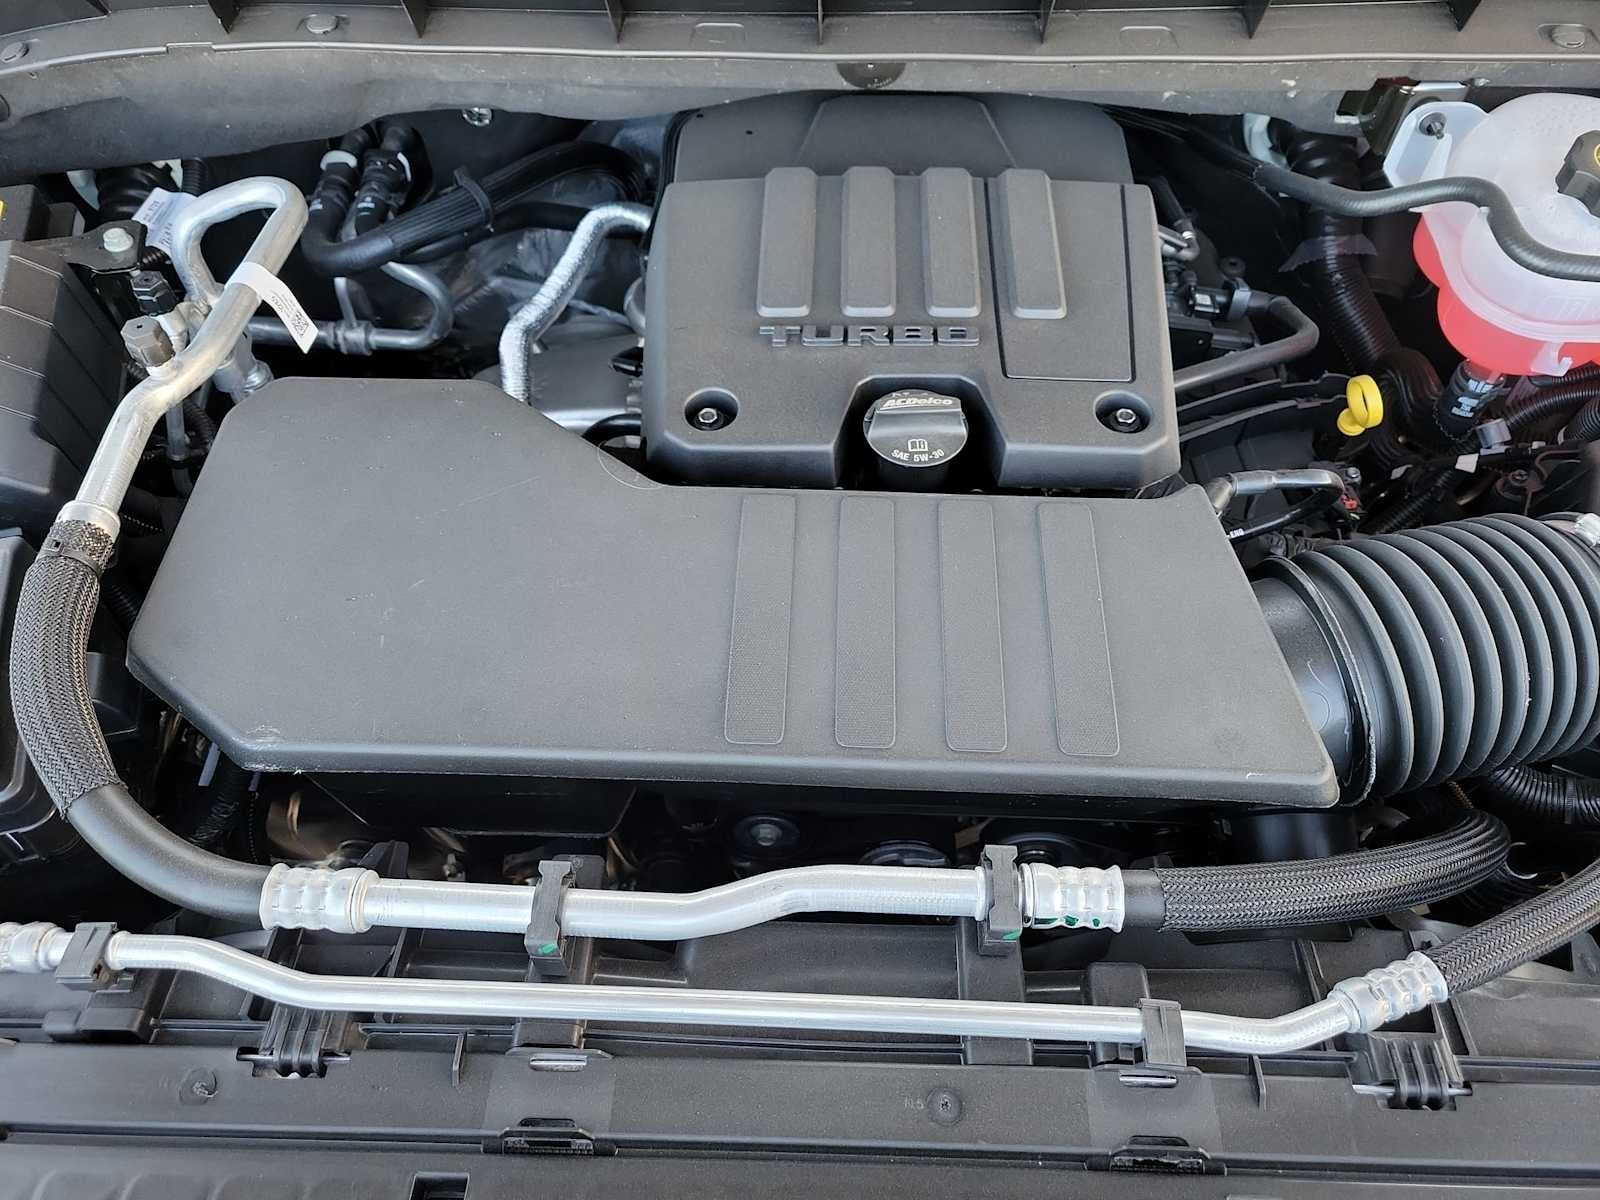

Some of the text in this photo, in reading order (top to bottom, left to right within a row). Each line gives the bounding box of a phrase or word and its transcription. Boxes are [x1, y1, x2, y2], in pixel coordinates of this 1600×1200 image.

[758, 325, 980, 347] TURBO
[881, 397, 953, 409] ACDelco
[891, 448, 945, 462] SAE 5W-30
